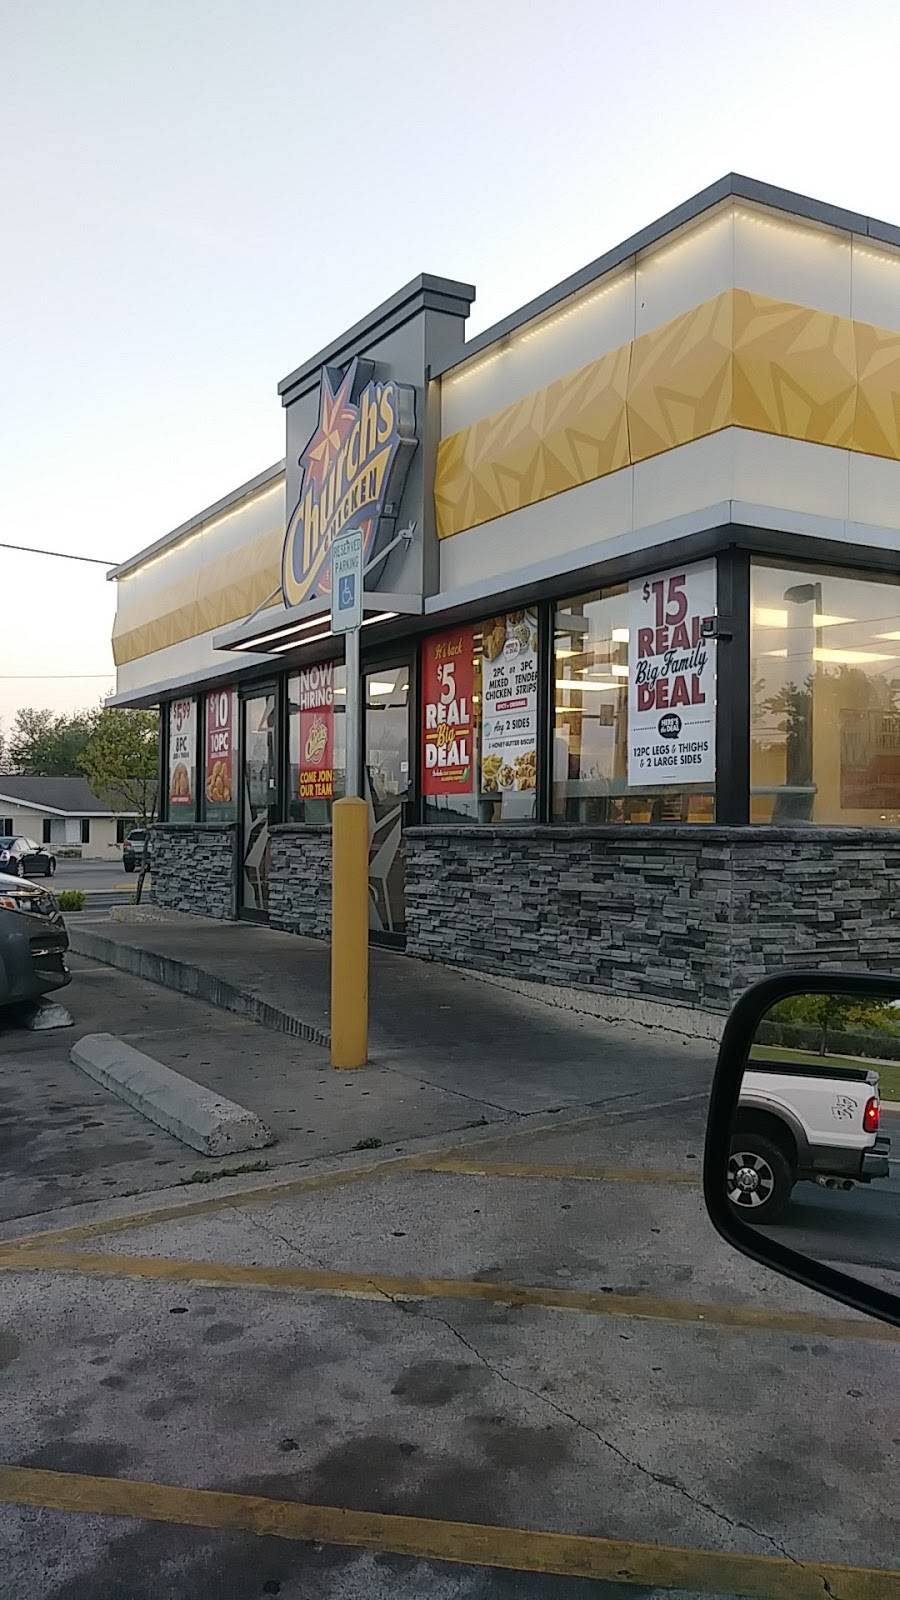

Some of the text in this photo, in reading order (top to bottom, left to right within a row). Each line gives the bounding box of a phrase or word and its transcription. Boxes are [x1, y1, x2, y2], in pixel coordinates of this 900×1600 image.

[285, 384, 394, 607] Church's
[335, 555, 360, 573] PARKING
[643, 574, 688, 627] $15
[300, 663, 333, 690] NOW
[493, 666, 505, 678] 2PC
[520, 660, 533, 672] 3PC
[635, 645, 708, 688] Big Family
[437, 662, 456, 705] $5
[485, 682, 537, 701] CHICKEN STRIPS
[488, 677, 509, 690] MIXED
[637, 674, 706, 712] DEAL
[210, 690, 229, 728] $10
[300, 687, 333, 711] HIRING
[425, 697, 470, 729] REAL
[505, 720, 511, 731] 2
[512, 717, 530, 730] SIDES
[211, 732, 229, 752] 10PC
[436, 723, 457, 750] Big
[633, 740, 709, 757] 12PC LEGS & THIGHS
[425, 739, 469, 768] DEAL
[647, 757, 652, 767] 2
[653, 755, 678, 767] LARGE
[680, 752, 702, 764] SIDES
[300, 769, 333, 785] COME JOIN
[300, 781, 333, 797] OUR TEAM
